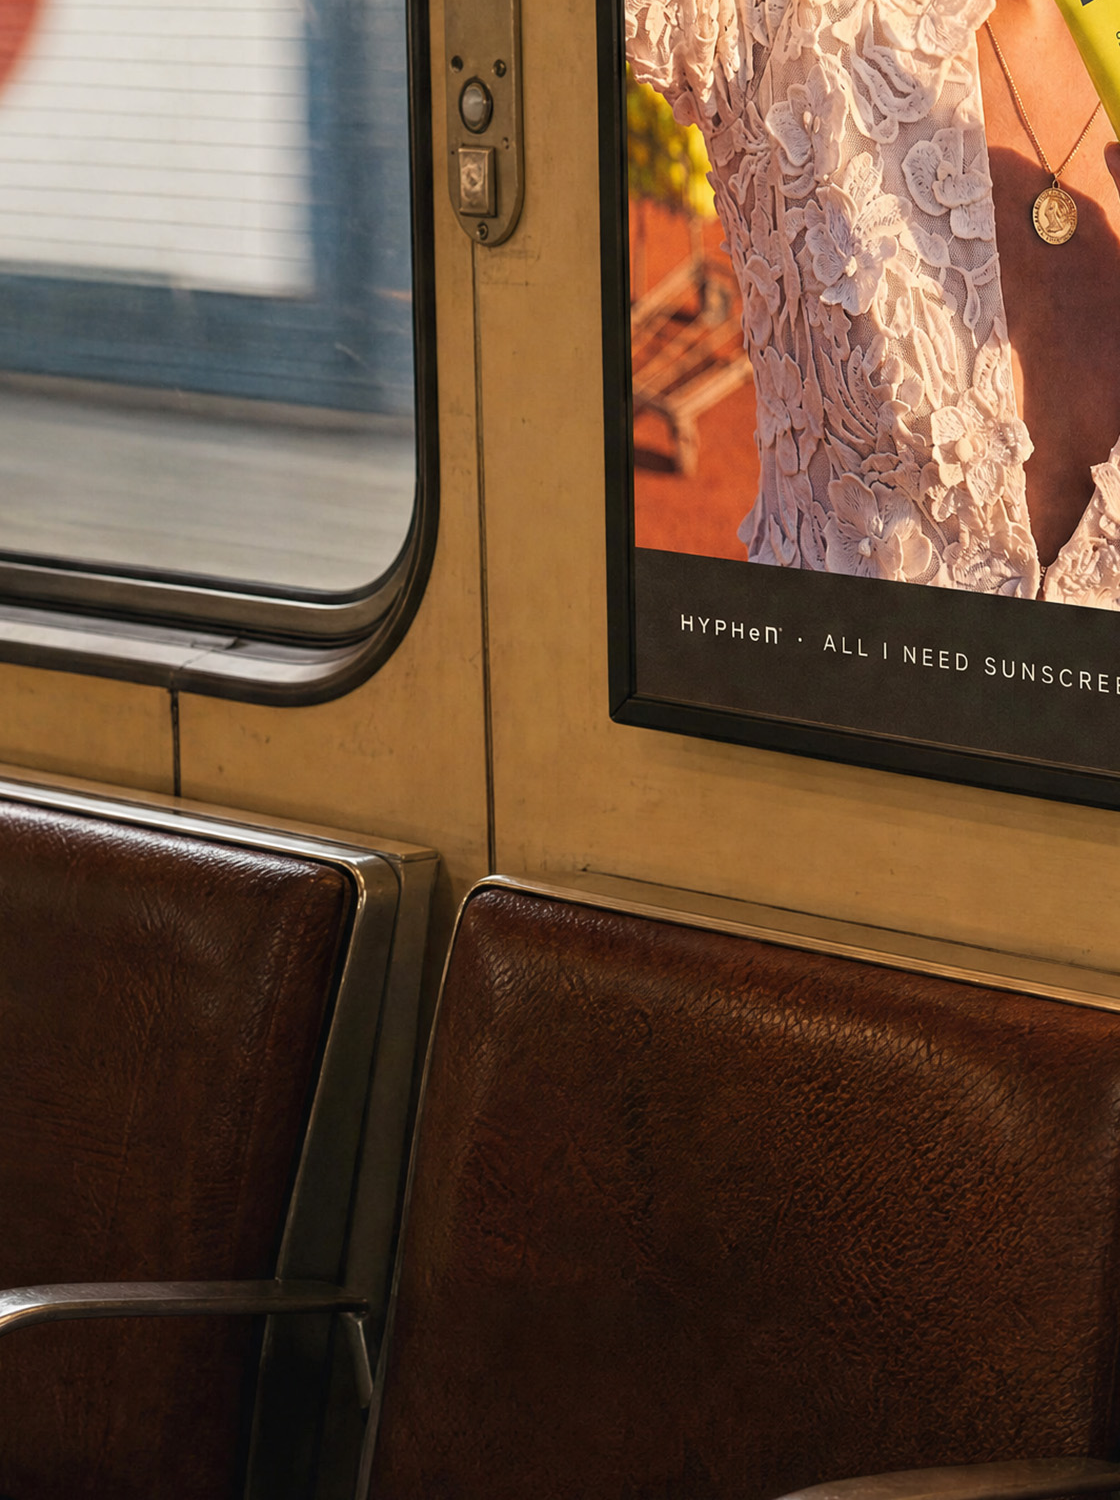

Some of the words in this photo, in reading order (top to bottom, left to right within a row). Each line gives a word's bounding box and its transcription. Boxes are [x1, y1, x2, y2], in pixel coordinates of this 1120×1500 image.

[823, 634, 869, 657] ALL
[883, 642, 888, 660] I
[903, 645, 969, 671] NEED
